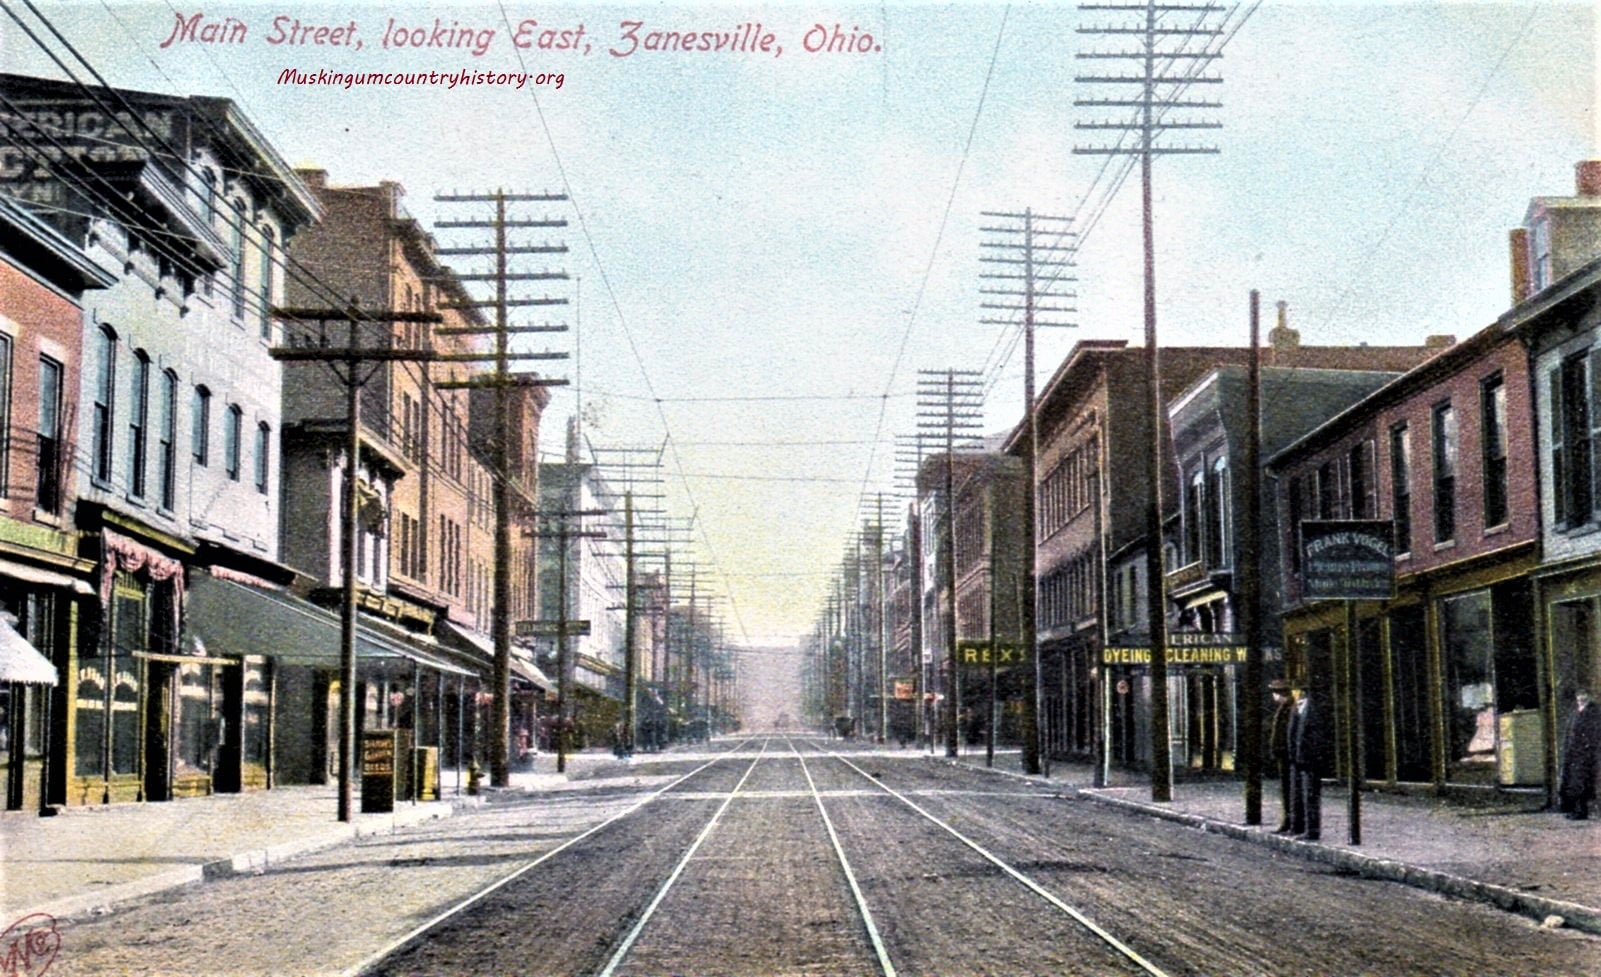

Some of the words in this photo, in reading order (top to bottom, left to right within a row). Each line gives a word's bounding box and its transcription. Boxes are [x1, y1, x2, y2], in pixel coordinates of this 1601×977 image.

[1170, 634, 1233, 645] ERICAN
[1103, 648, 1151, 663] DYEING
[1165, 648, 1231, 663] CLEANING
